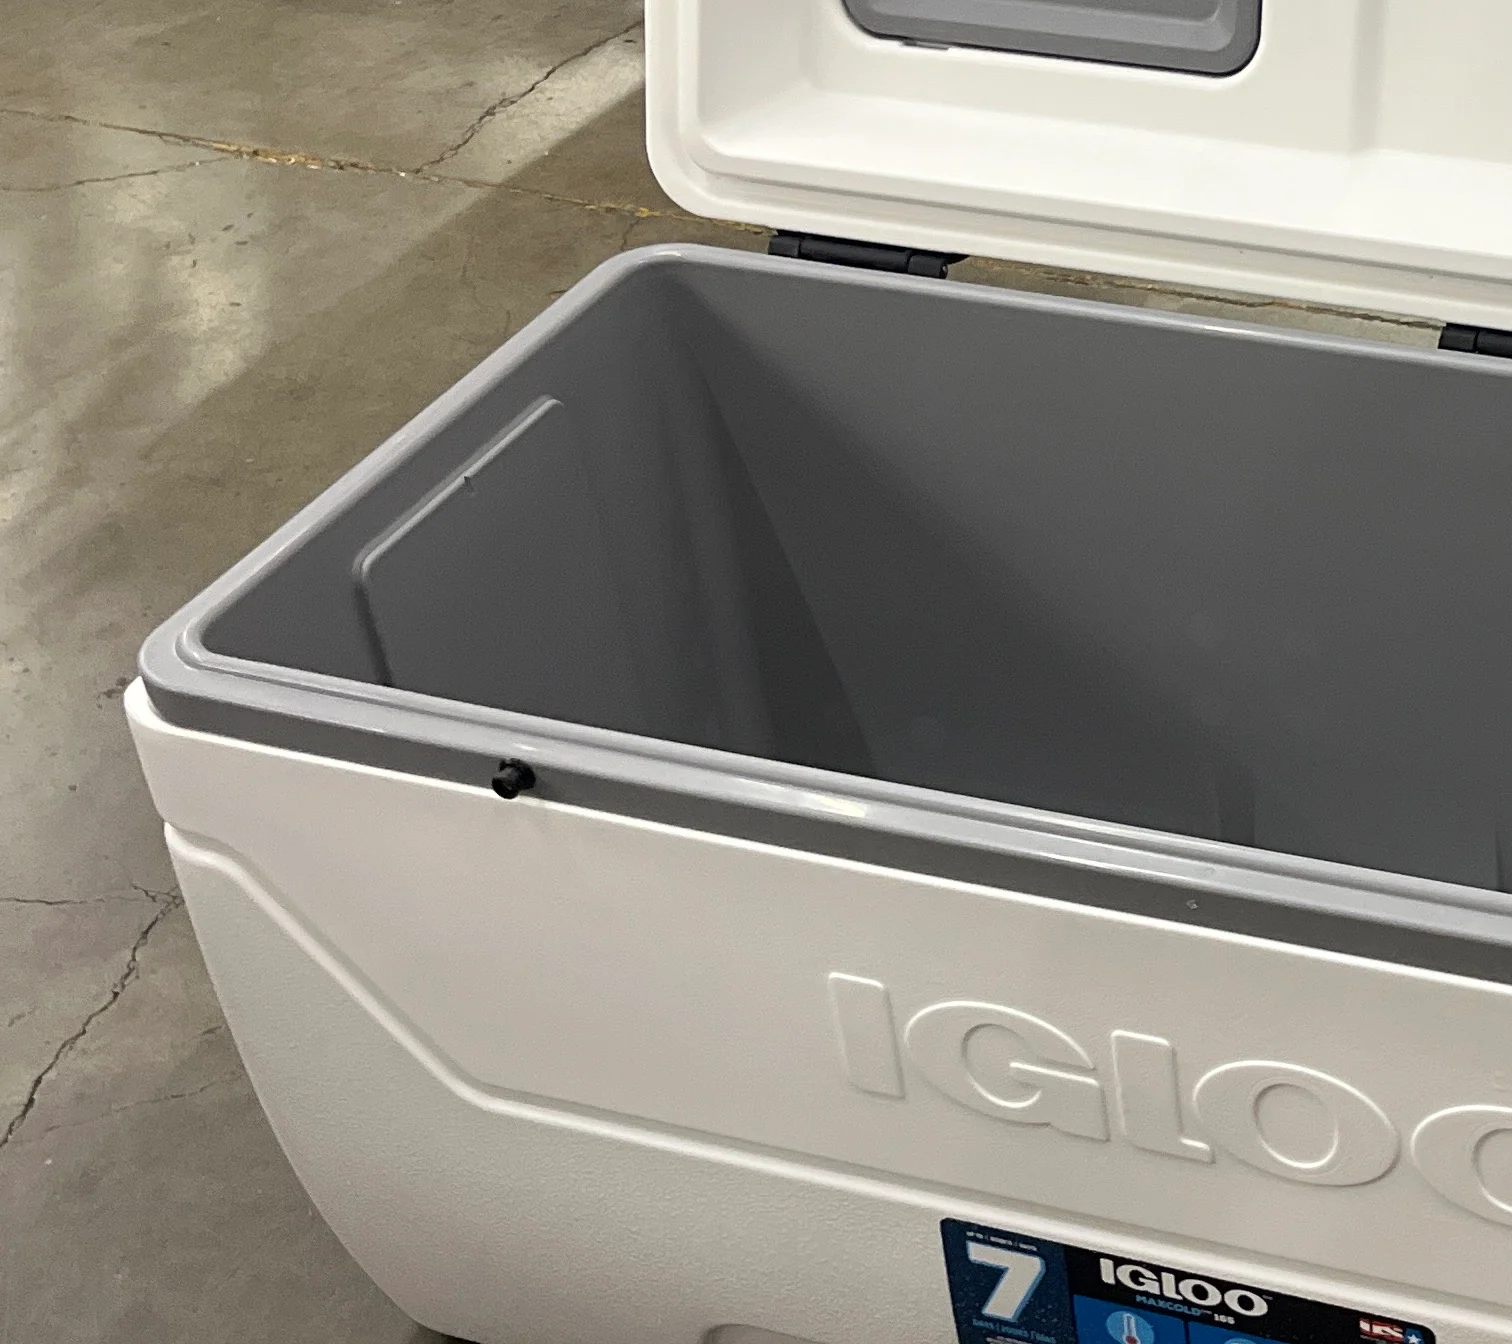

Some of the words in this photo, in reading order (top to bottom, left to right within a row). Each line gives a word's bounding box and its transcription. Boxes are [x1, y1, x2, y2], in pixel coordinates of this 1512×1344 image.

[966, 1240, 1047, 1322] 7
[1100, 1258, 1269, 1317] IGLOO
[1136, 1294, 1202, 1316] MAXCOLD
